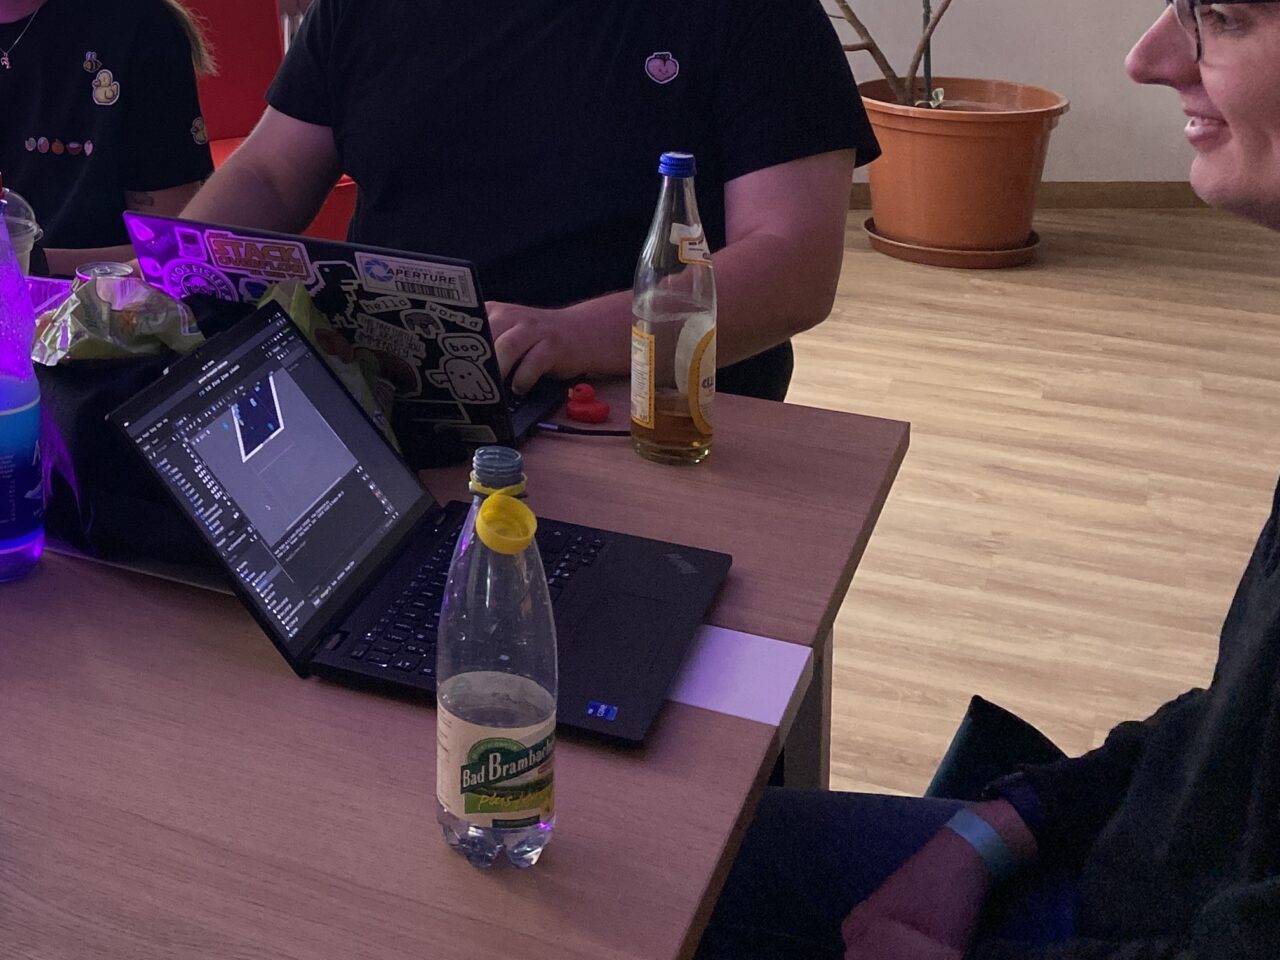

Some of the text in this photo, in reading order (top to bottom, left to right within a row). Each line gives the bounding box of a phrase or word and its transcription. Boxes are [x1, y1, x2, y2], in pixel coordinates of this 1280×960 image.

[213, 240, 302, 261] STACK
[171, 264, 190, 283] MOS
[386, 267, 458, 285] APERTURE
[366, 298, 407, 311] hello
[429, 304, 478, 328] world
[449, 342, 479, 352] boo
[462, 764, 485, 788] Bad
